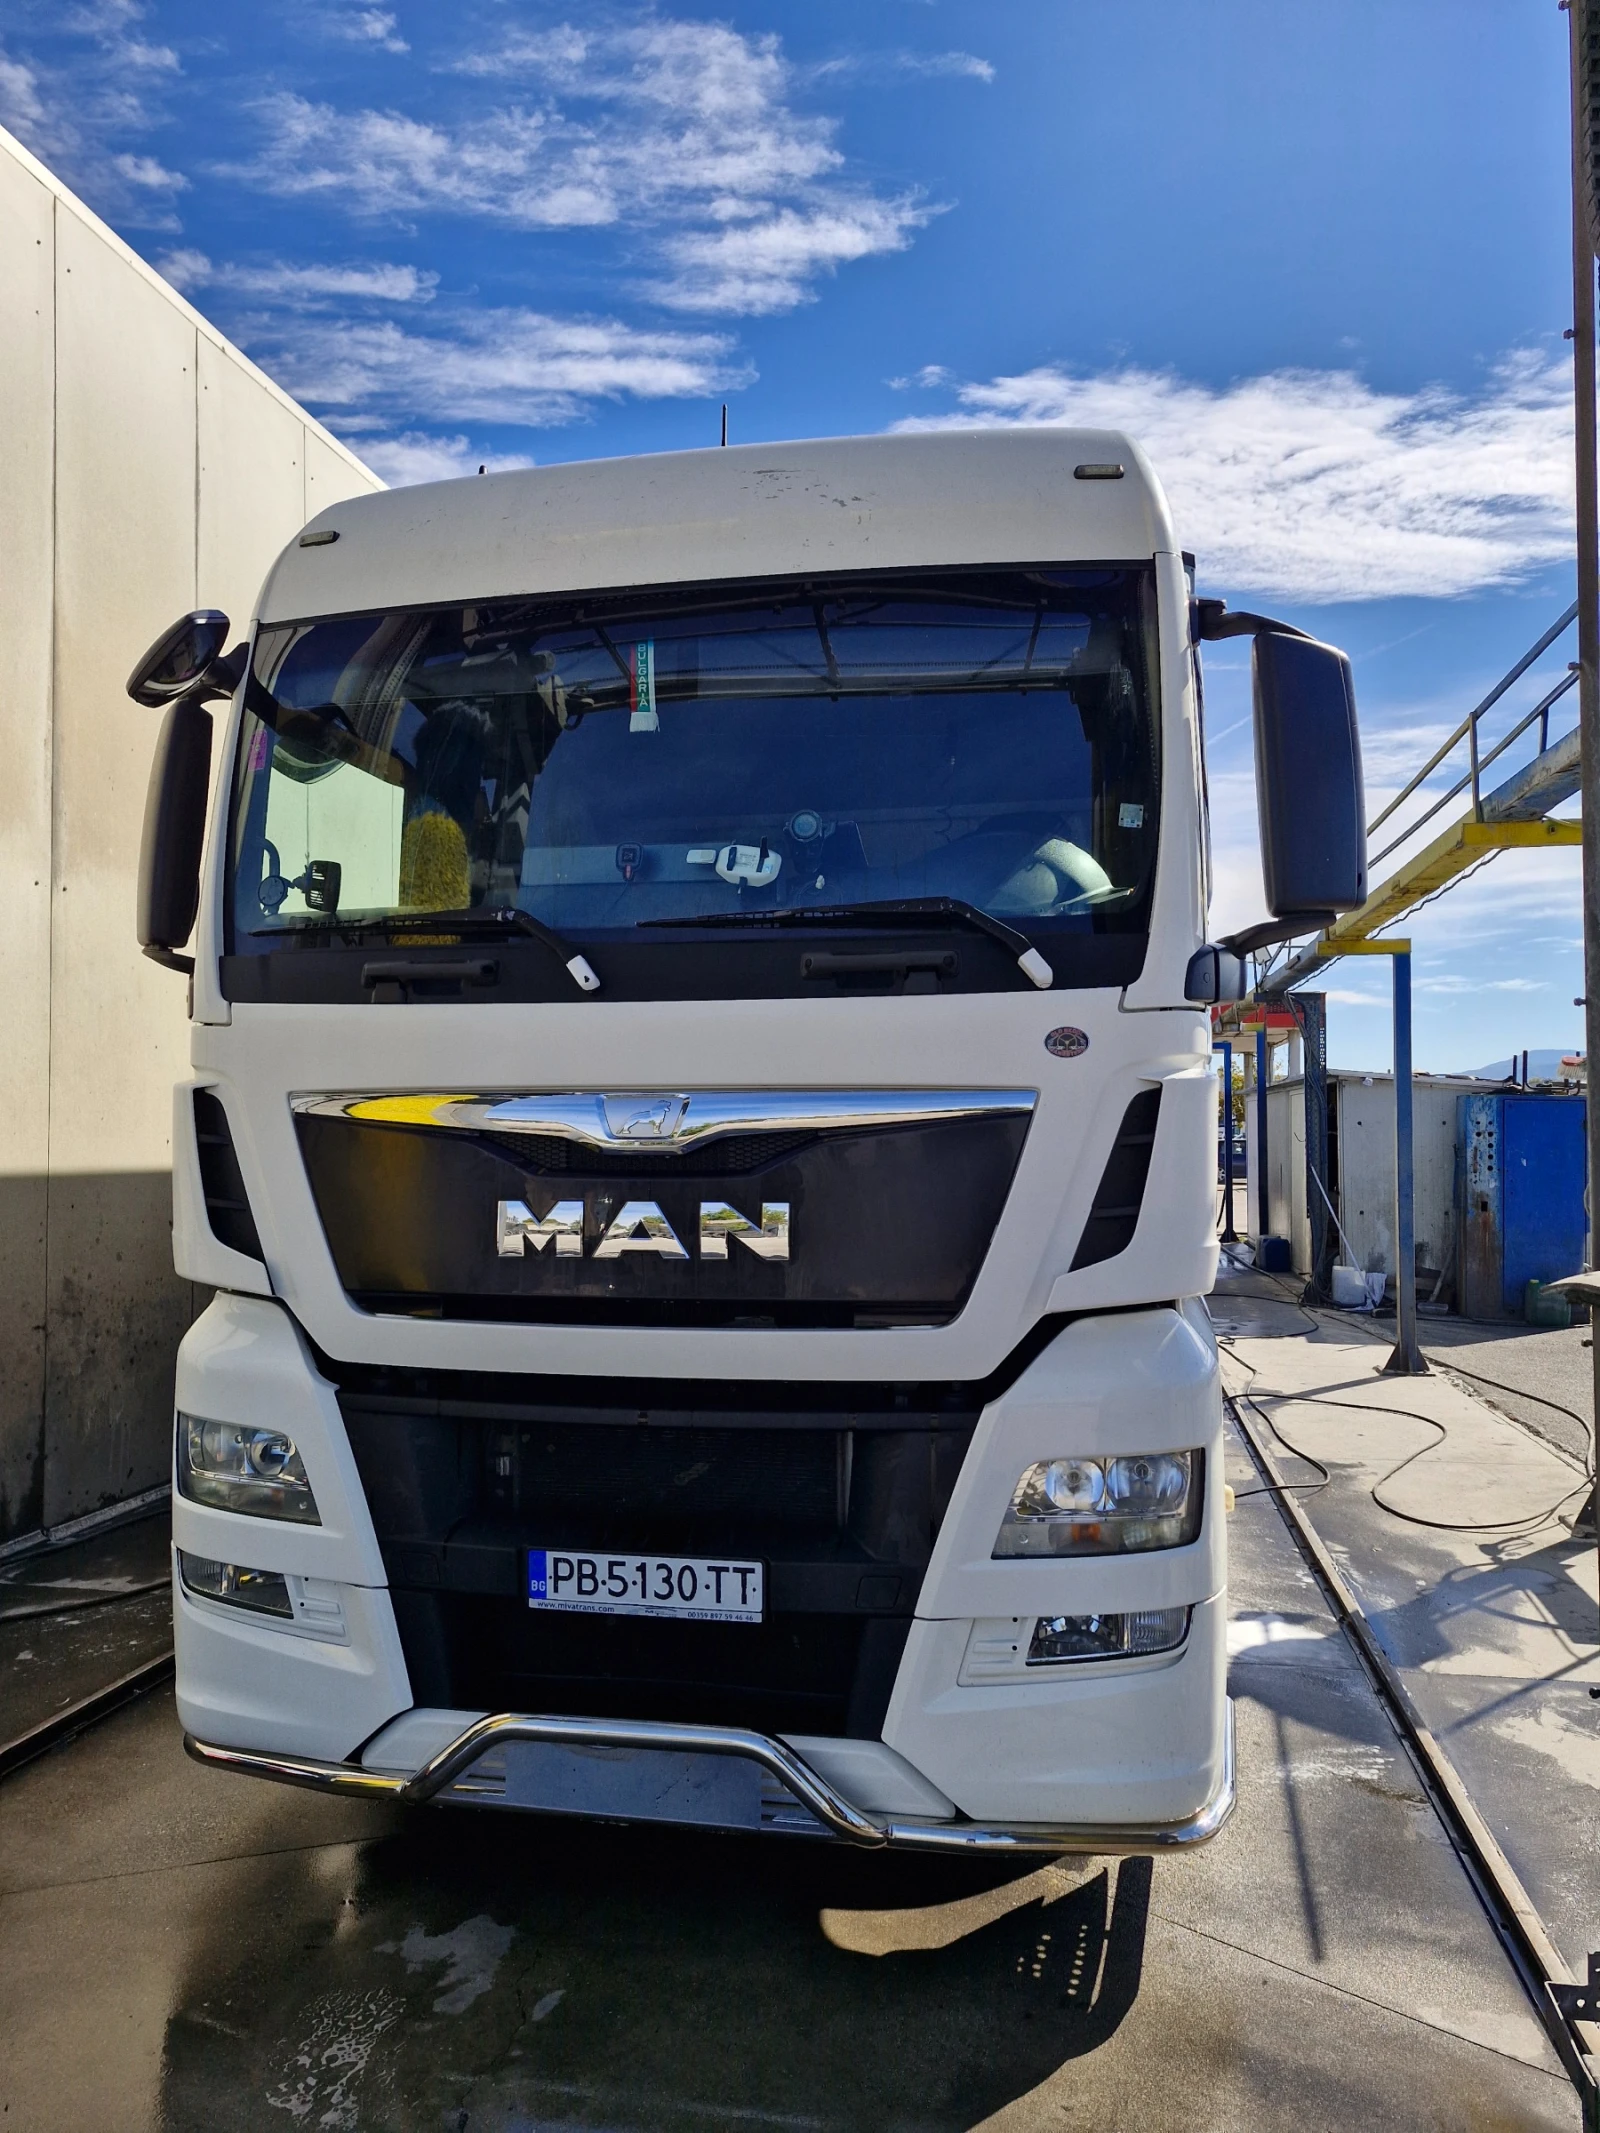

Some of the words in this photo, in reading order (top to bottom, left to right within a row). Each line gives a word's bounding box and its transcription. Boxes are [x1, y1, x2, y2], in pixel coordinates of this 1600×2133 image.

[637, 643, 648, 707] BULGARIA
[497, 1200, 790, 1260] MAN
[531, 1579, 546, 1592] BG
[537, 1601, 615, 1613] www.mivatrans.com
[687, 1611, 709, 1619] 00359
[710, 1612, 723, 1620] 897
